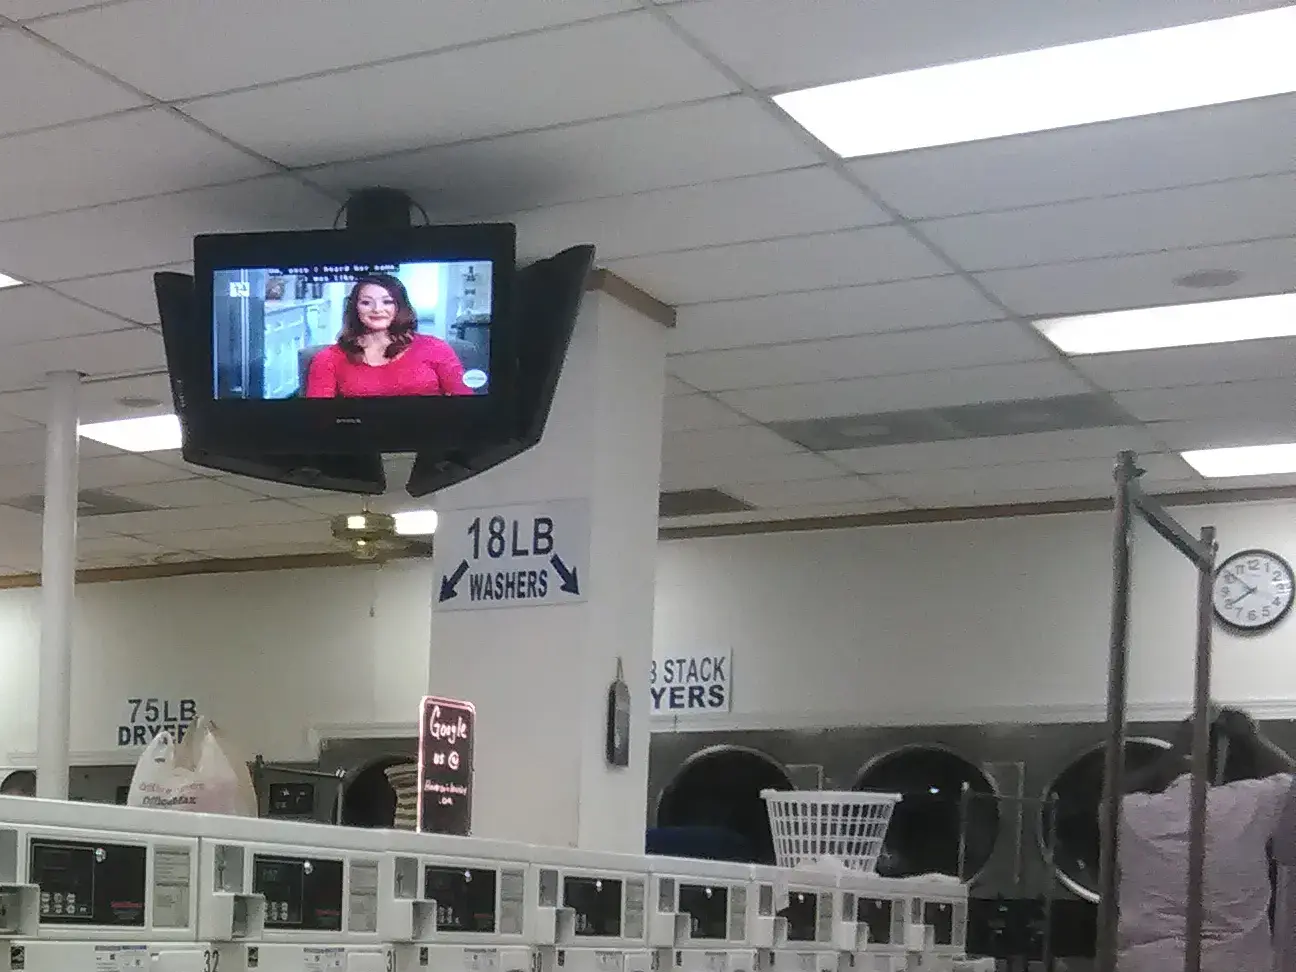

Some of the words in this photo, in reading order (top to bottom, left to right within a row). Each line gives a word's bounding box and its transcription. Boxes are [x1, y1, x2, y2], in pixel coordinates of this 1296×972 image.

[468, 515, 554, 560] 18LB
[469, 569, 548, 601] WASHERS
[663, 656, 726, 684] STACK
[127, 698, 197, 723] 75LB
[650, 684, 725, 709] YERS
[429, 705, 468, 744] Google
[433, 752, 445, 765] us
